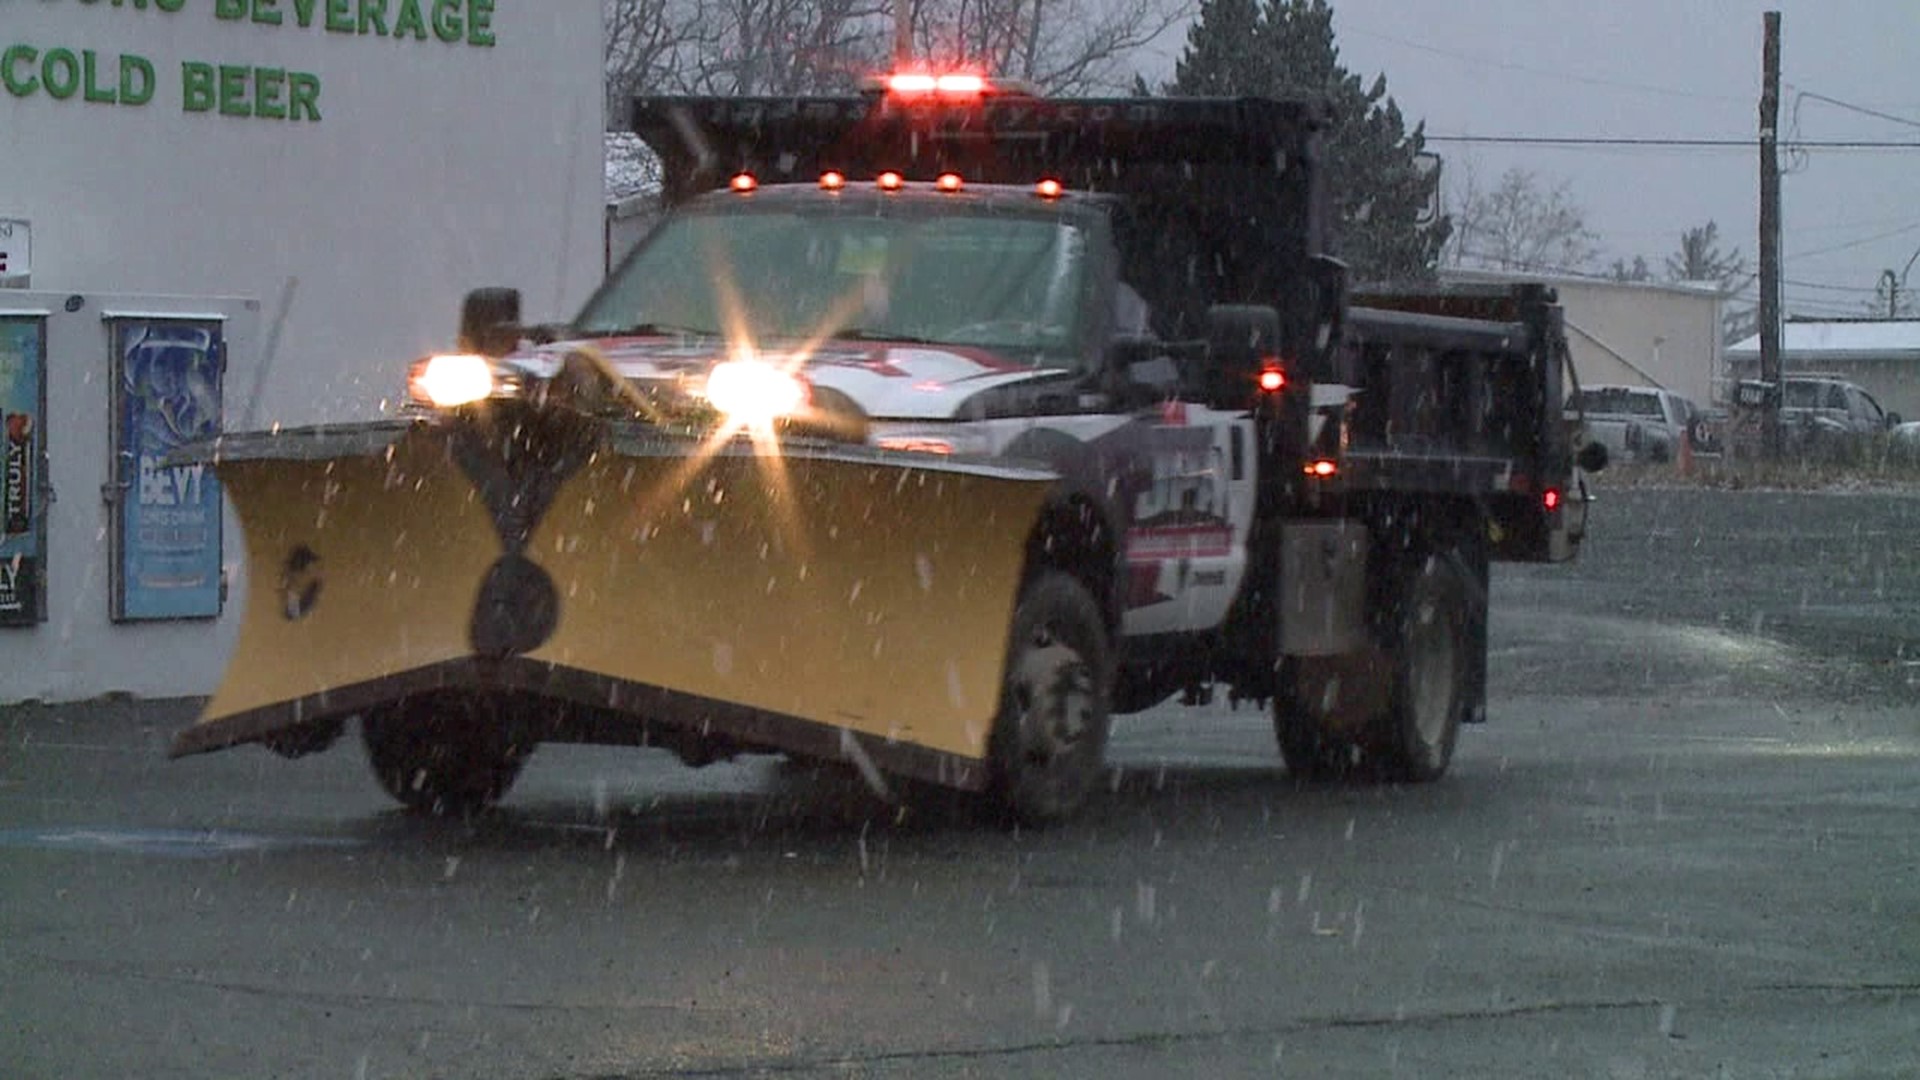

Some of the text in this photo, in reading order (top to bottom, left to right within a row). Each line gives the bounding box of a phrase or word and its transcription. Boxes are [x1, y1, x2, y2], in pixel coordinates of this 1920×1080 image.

[2, 44, 323, 121] COLD BEER
[8, 442, 23, 514] TRULY
